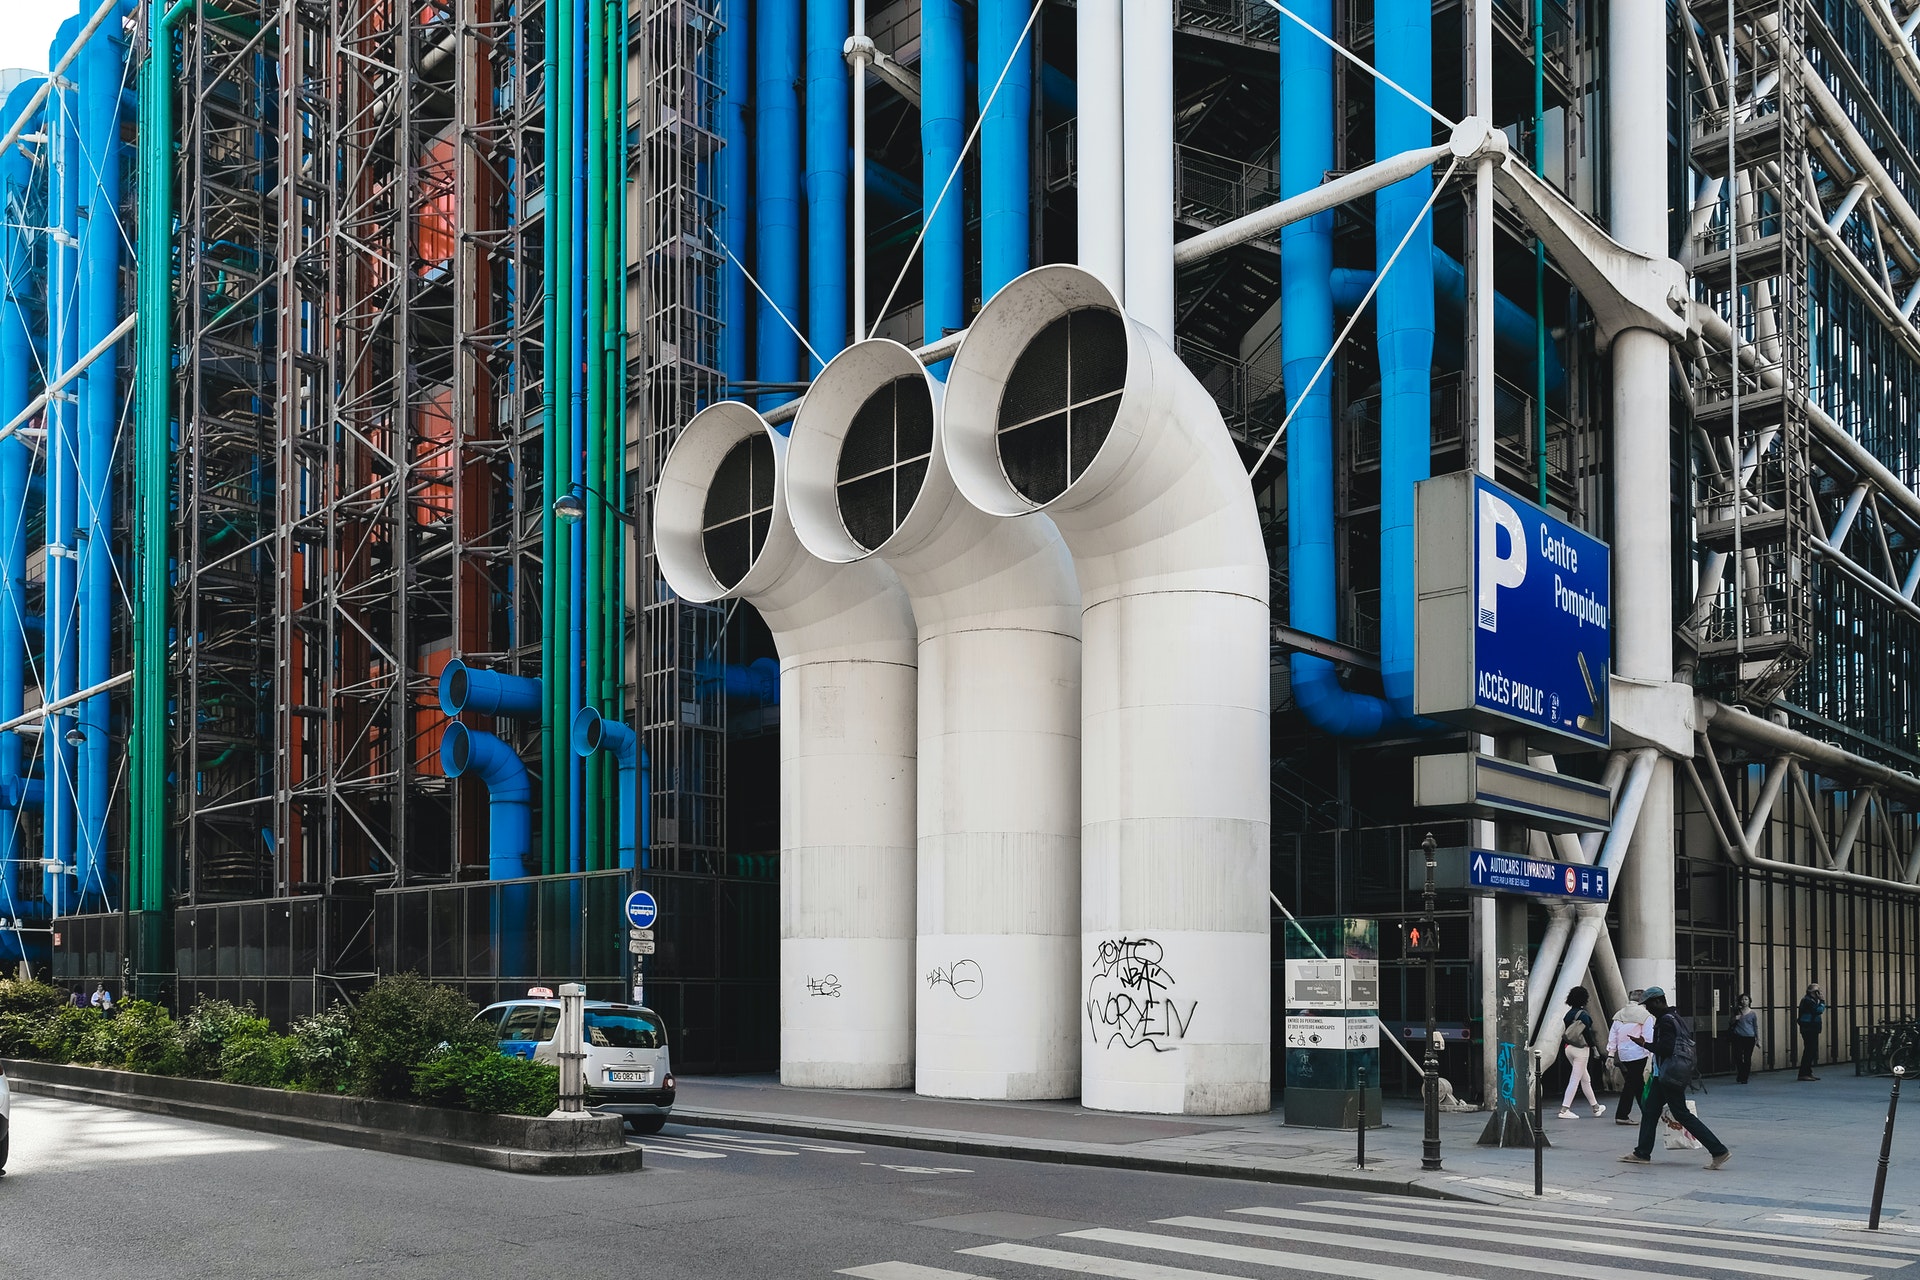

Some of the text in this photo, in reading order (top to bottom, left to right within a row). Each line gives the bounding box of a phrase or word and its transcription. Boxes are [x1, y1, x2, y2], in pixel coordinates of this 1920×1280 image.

[1479, 488, 1527, 633] P
[1540, 522, 1578, 574] Centre
[1554, 573, 1607, 630] Pompidou
[1478, 670, 1544, 716] ACCÈS PUBLIC
[1490, 857, 1520, 876] AUTOCARS
[1524, 862, 1556, 880] LIVRAISONS
